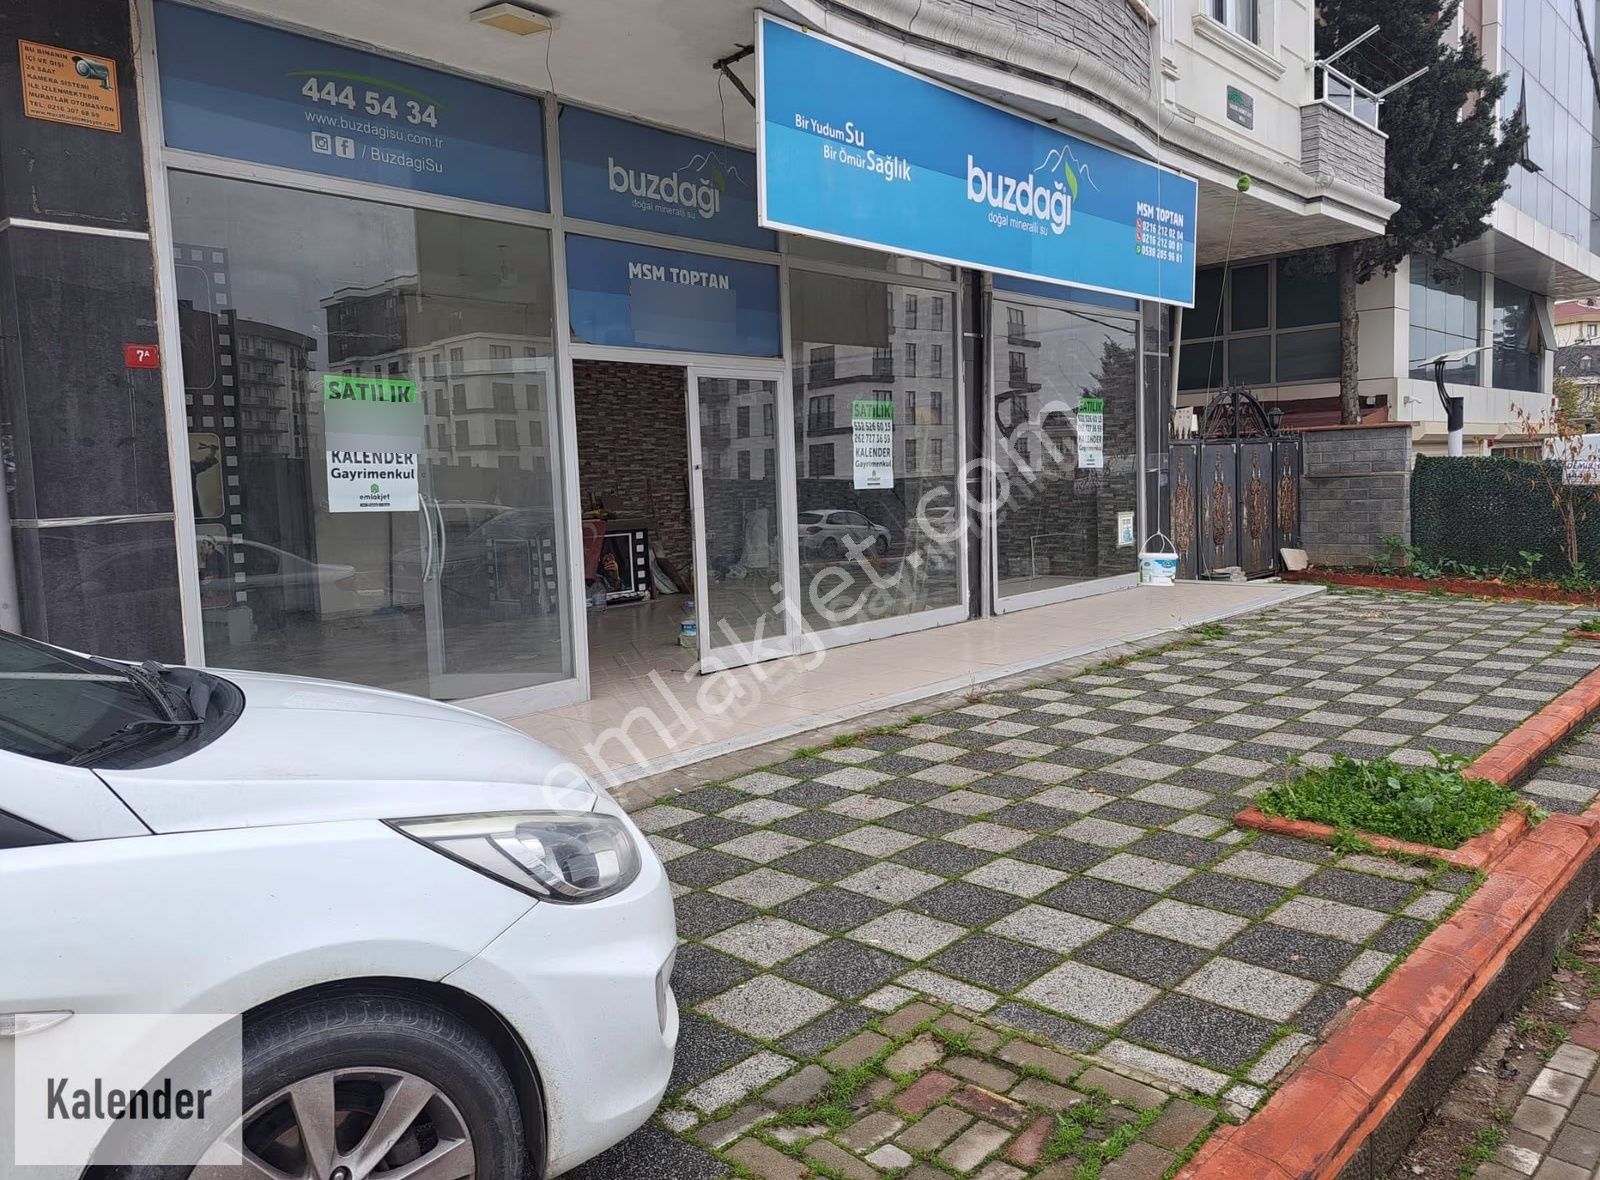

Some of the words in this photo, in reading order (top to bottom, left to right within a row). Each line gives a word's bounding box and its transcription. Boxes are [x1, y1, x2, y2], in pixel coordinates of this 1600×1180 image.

[27, 73, 59, 84] KAMERA
[28, 91, 69, 104] MURATLAR
[70, 98, 114, 112] OTOMASYON
[302, 77, 356, 110] 444
[365, 90, 398, 119] 54
[406, 101, 438, 128] 34
[304, 111, 444, 149] www.buzdagisu.com.tr
[795, 113, 810, 129] Bir
[810, 118, 845, 141] Yudum
[845, 122, 865, 147] Su
[371, 147, 443, 173] BuzdagiSu
[823, 144, 837, 160] Bir
[839, 146, 866, 168] Ömür
[866, 149, 911, 182] Sağlık
[988, 211, 1009, 228] doğal
[1039, 226, 1048, 236] su
[1136, 201, 1154, 219] MSM
[1155, 207, 1184, 227] TOPTAN
[1142, 220, 1157, 234] 0216
[1157, 225, 1168, 237] 212
[1142, 233, 1156, 245] 0216
[1157, 236, 1167, 248] 212
[628, 262, 665, 281] MSM
[670, 268, 729, 290] TOPTAN
[328, 381, 411, 402] SATILIK
[854, 404, 891, 418] SATILIK
[332, 451, 413, 464] KALENDER
[855, 447, 891, 458] KALENDER
[330, 468, 414, 481] Gayrimenkul
[855, 460, 891, 469] Gayrimenkul
